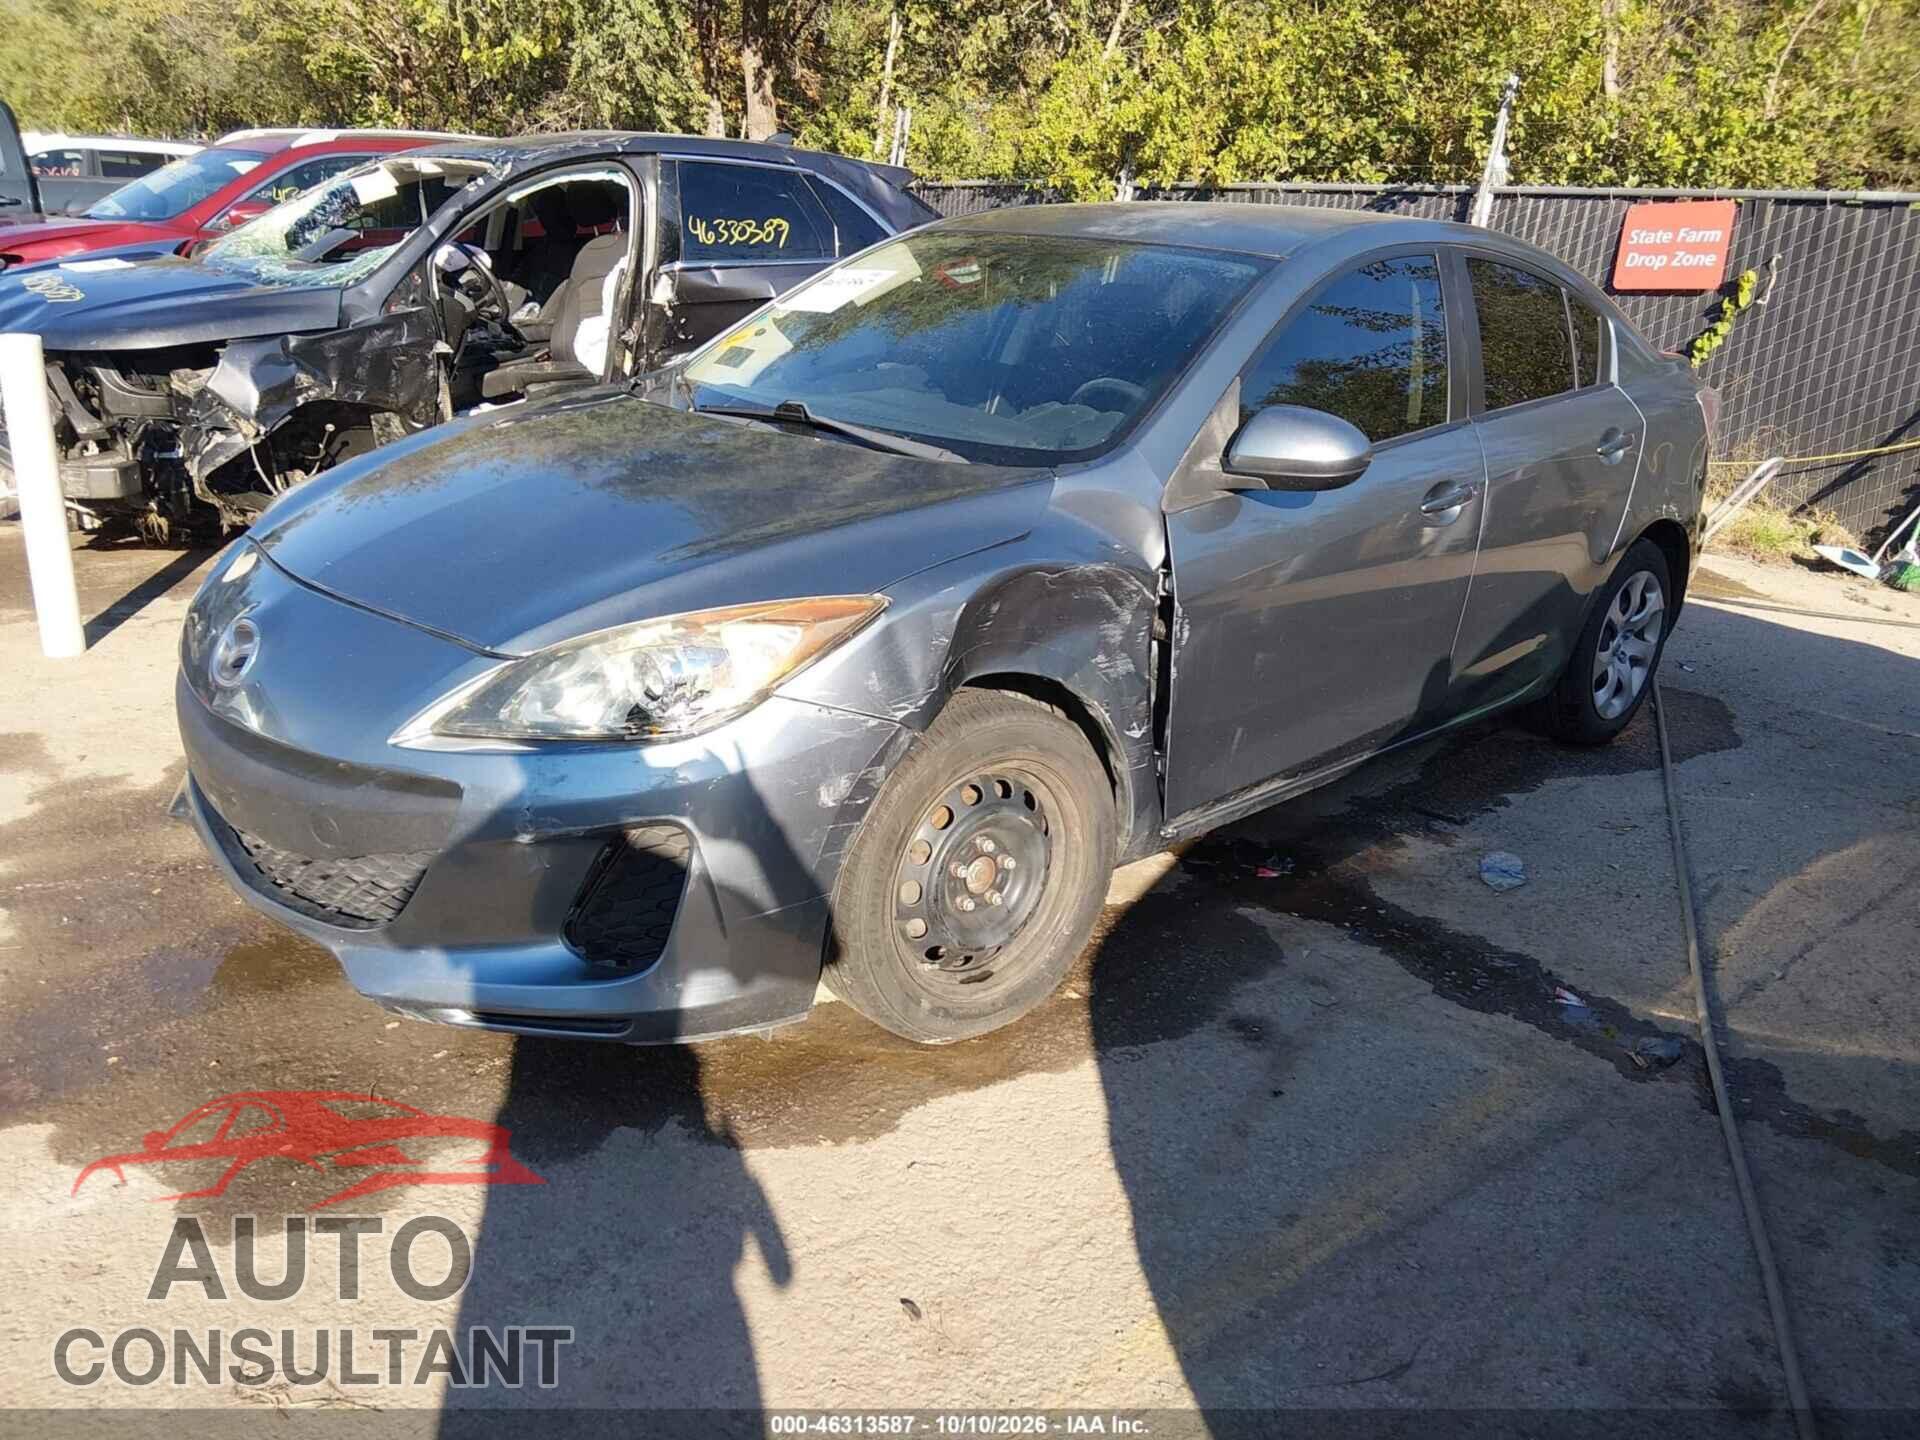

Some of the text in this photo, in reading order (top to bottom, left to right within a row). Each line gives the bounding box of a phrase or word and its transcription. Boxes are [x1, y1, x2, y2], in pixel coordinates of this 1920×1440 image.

[1628, 228, 1722, 244] State Farm
[1625, 251, 1717, 270] Drop Zone
